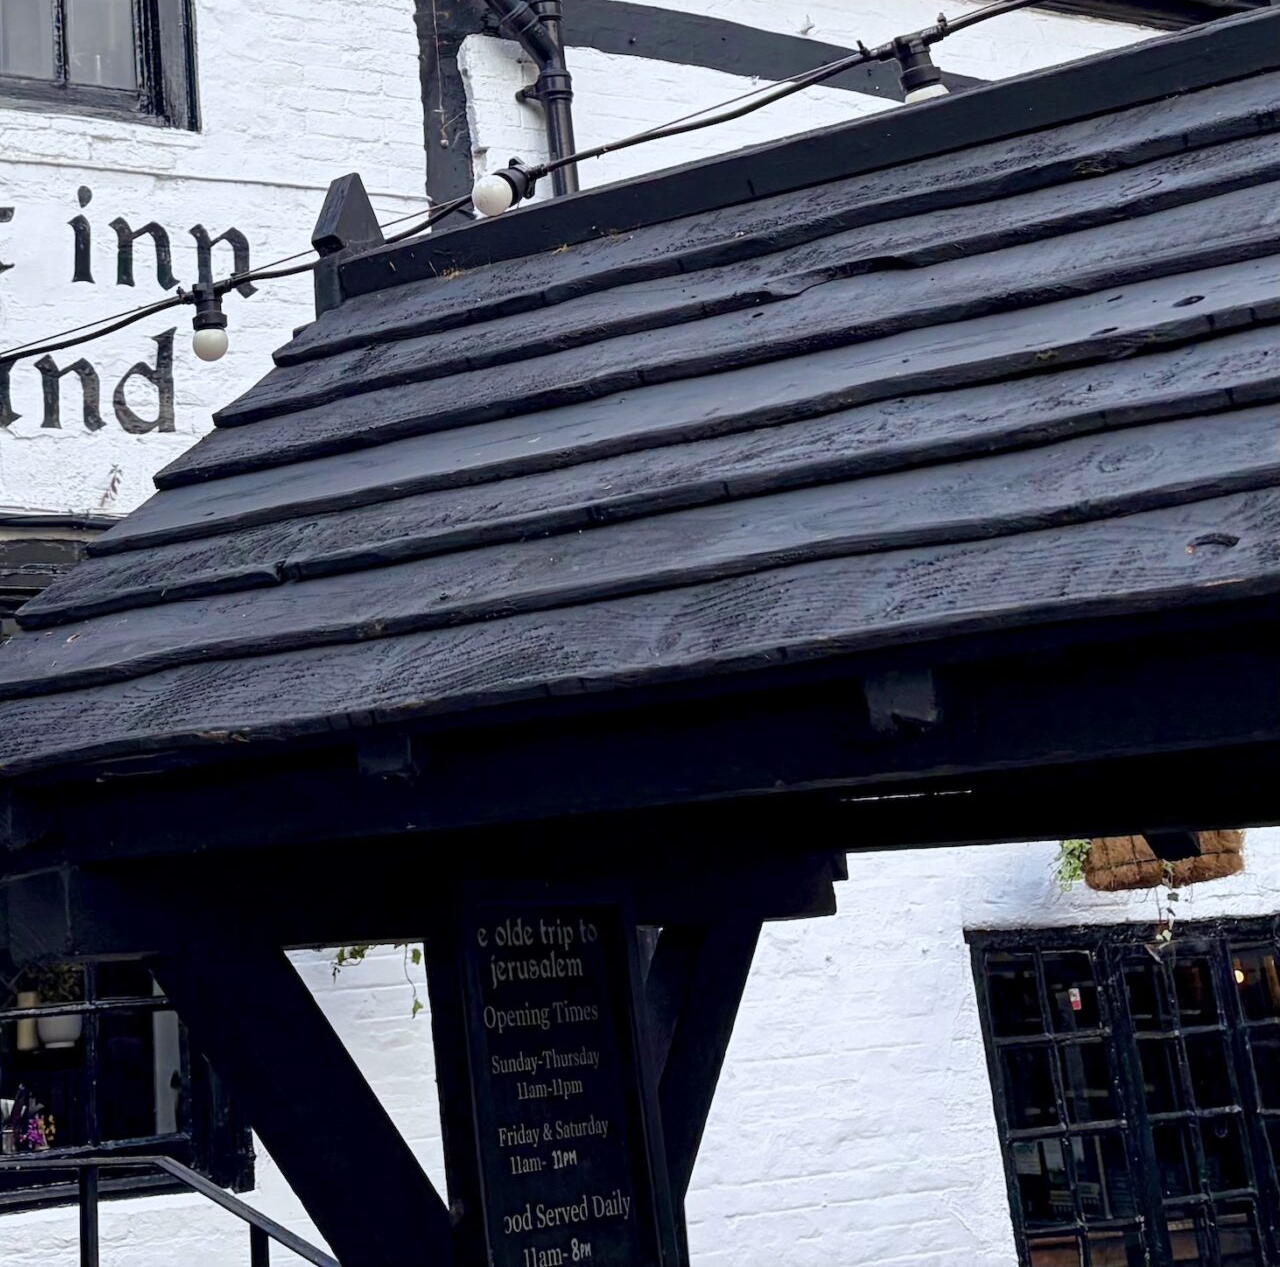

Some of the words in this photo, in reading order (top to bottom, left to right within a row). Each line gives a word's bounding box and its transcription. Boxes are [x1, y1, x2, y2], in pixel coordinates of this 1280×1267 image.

[67, 185, 259, 299] inn
[494, 917, 534, 947] olde
[539, 918, 574, 951] trip
[579, 918, 599, 944] to
[490, 950, 584, 989] jerusalem
[483, 1002, 551, 1034] Opening
[552, 1000, 599, 1023] Times
[491, 1045, 600, 1075] Sunday-Thursday
[516, 1078, 584, 1100] 11am-11pm
[497, 1123, 540, 1148] Friday
[542, 1123, 553, 1141] &
[555, 1113, 609, 1140] Saturday
[503, 1203, 533, 1234] ood
[535, 1194, 589, 1228] Served
[591, 1189, 631, 1220] Daily
